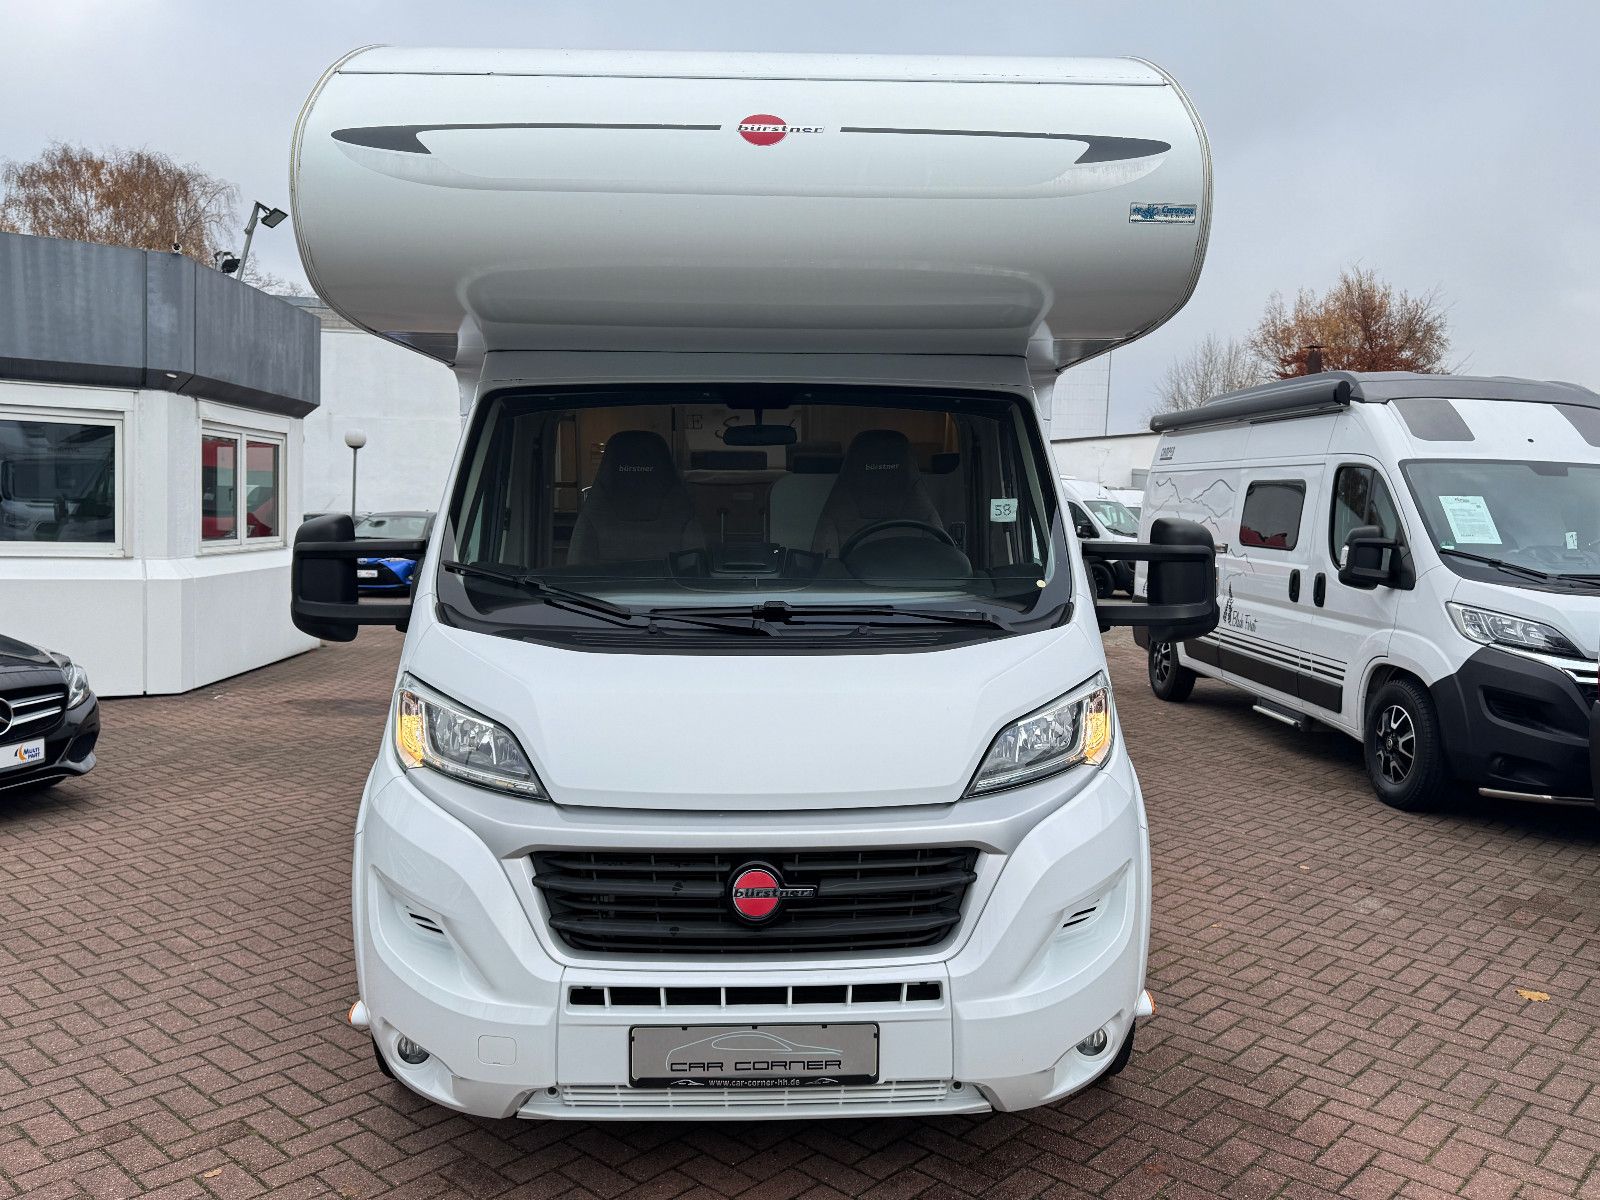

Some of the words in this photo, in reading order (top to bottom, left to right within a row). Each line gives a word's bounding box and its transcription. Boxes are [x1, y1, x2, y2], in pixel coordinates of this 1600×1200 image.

[737, 124, 824, 133] bürstner
[994, 503, 1012, 516] 58
[670, 1061, 724, 1072] CAR
[734, 1060, 842, 1071] CORNER
[708, 1078, 801, 1087] www.car-corner-hh.de
